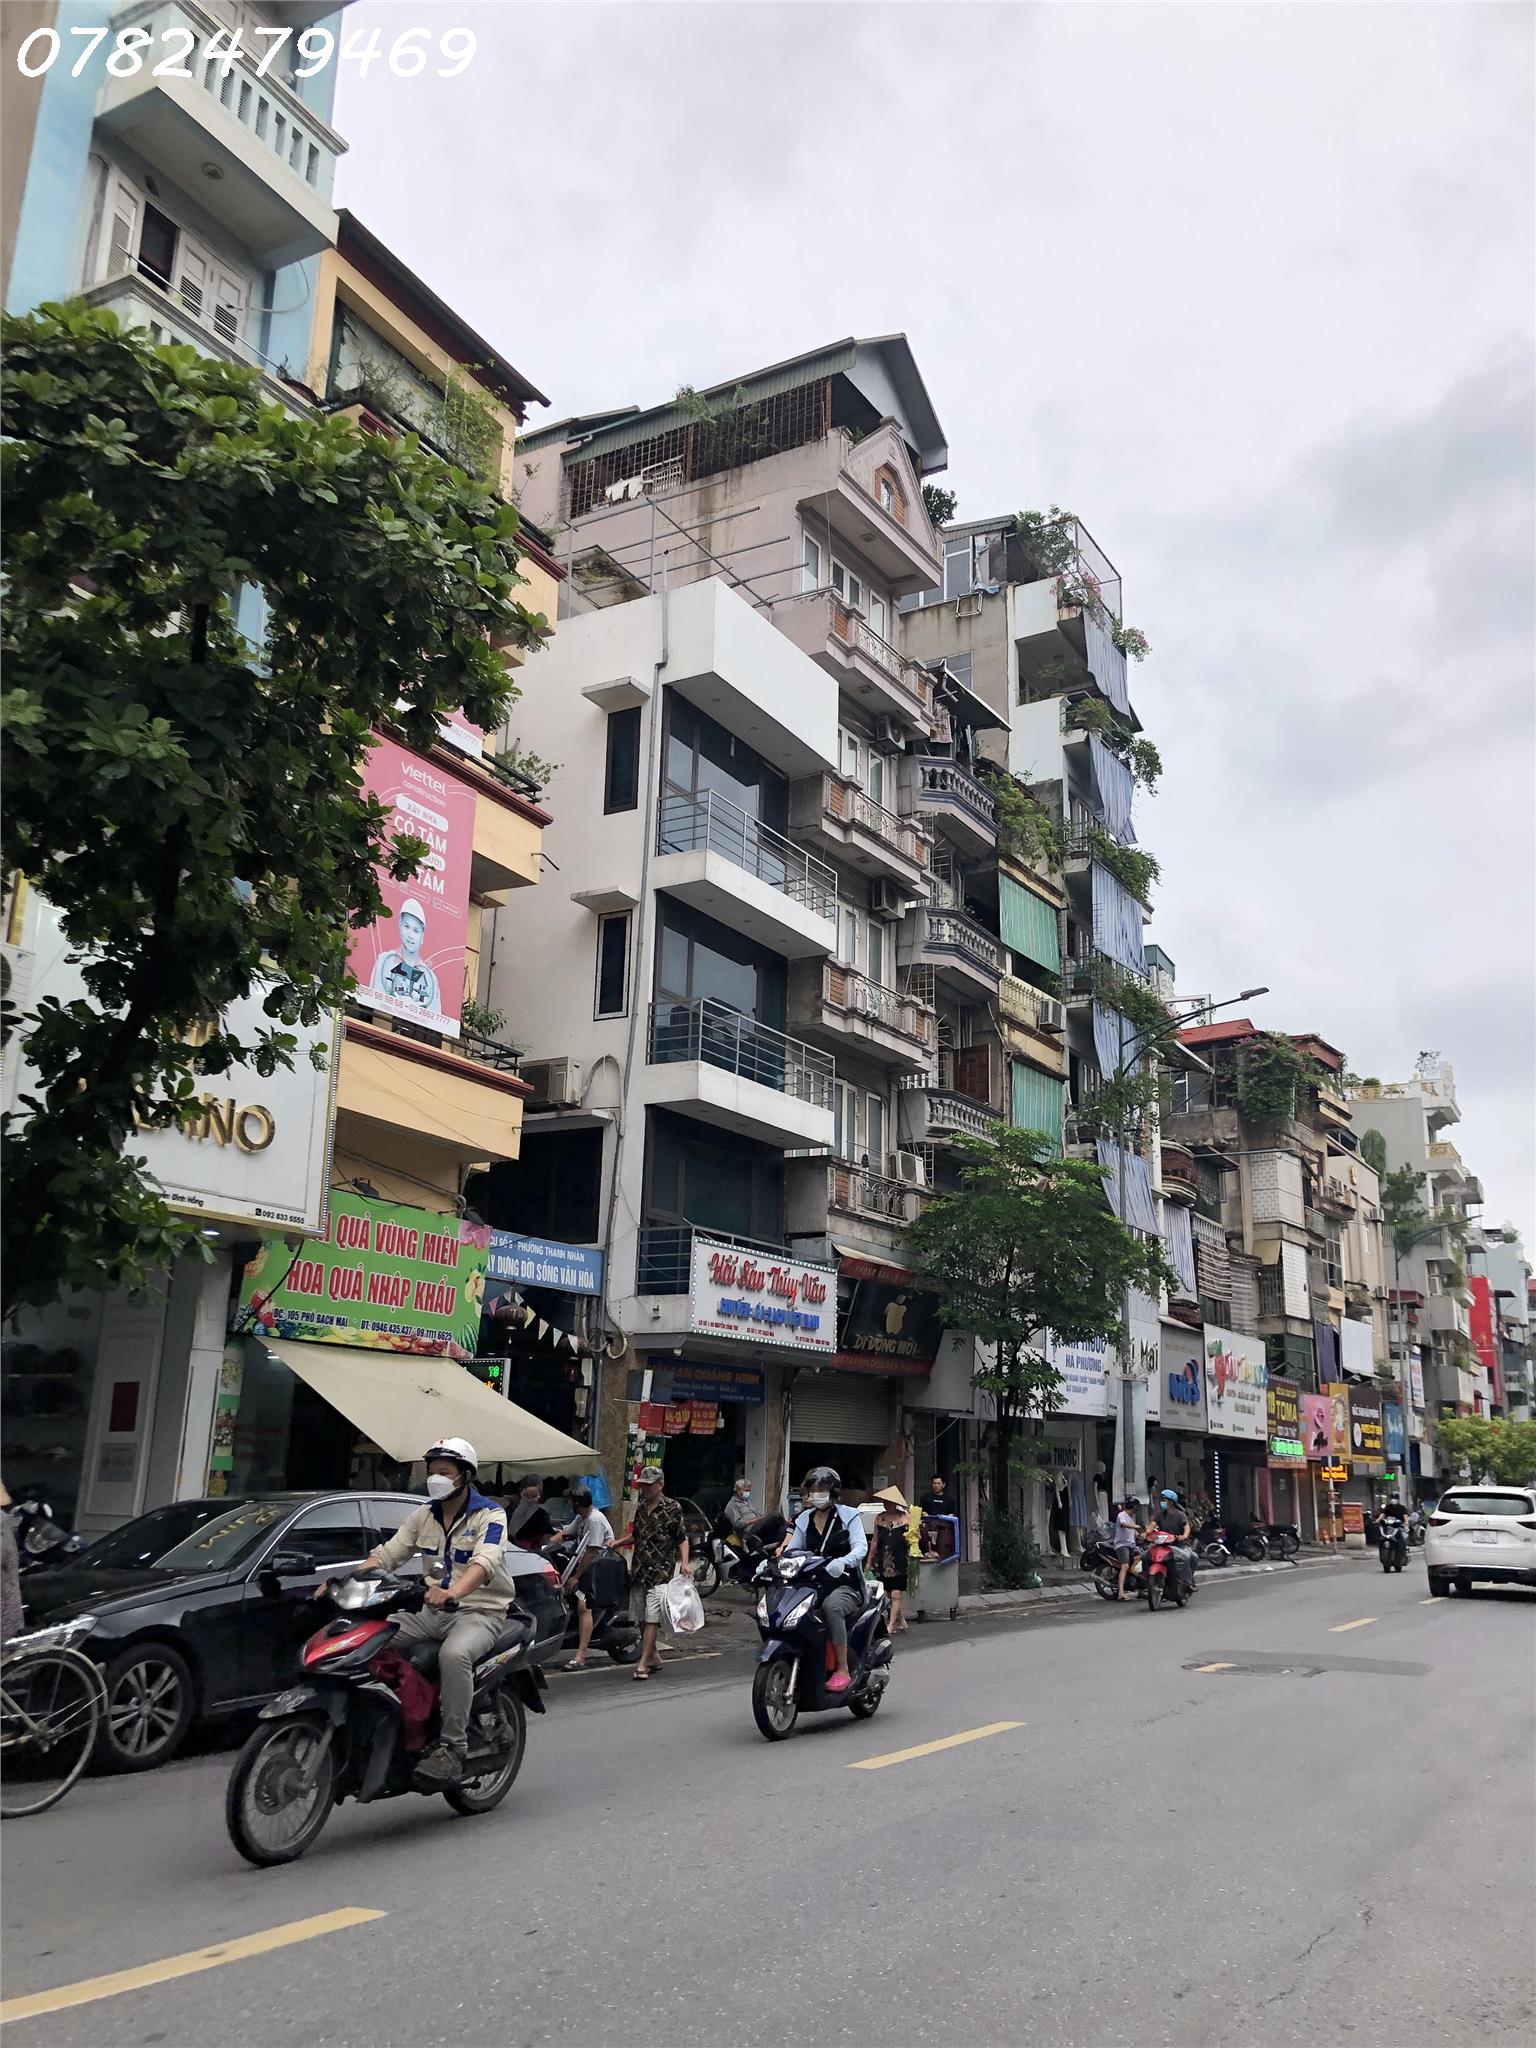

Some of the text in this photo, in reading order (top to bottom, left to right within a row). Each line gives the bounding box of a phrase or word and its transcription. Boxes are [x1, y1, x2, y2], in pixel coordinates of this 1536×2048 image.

[401, 761, 447, 797] viettel
[417, 825, 448, 854] TÂM
[416, 866, 445, 896] TÂM
[336, 1212, 371, 1251] QUẢ
[375, 1219, 418, 1260] VÙNG
[421, 1226, 460, 1268] MIỀN
[545, 1246, 566, 1260] THANH
[521, 1257, 535, 1280] ĐỜI
[536, 1260, 559, 1284] SỐNG
[560, 1264, 577, 1286] VĂN
[578, 1267, 594, 1289] HÓA
[711, 1252, 740, 1286] Hải
[285, 1259, 457, 1316] HOA QUẢ NHẬP KHẨU
[287, 1309, 300, 1321] 105
[335, 1316, 349, 1328] MAI
